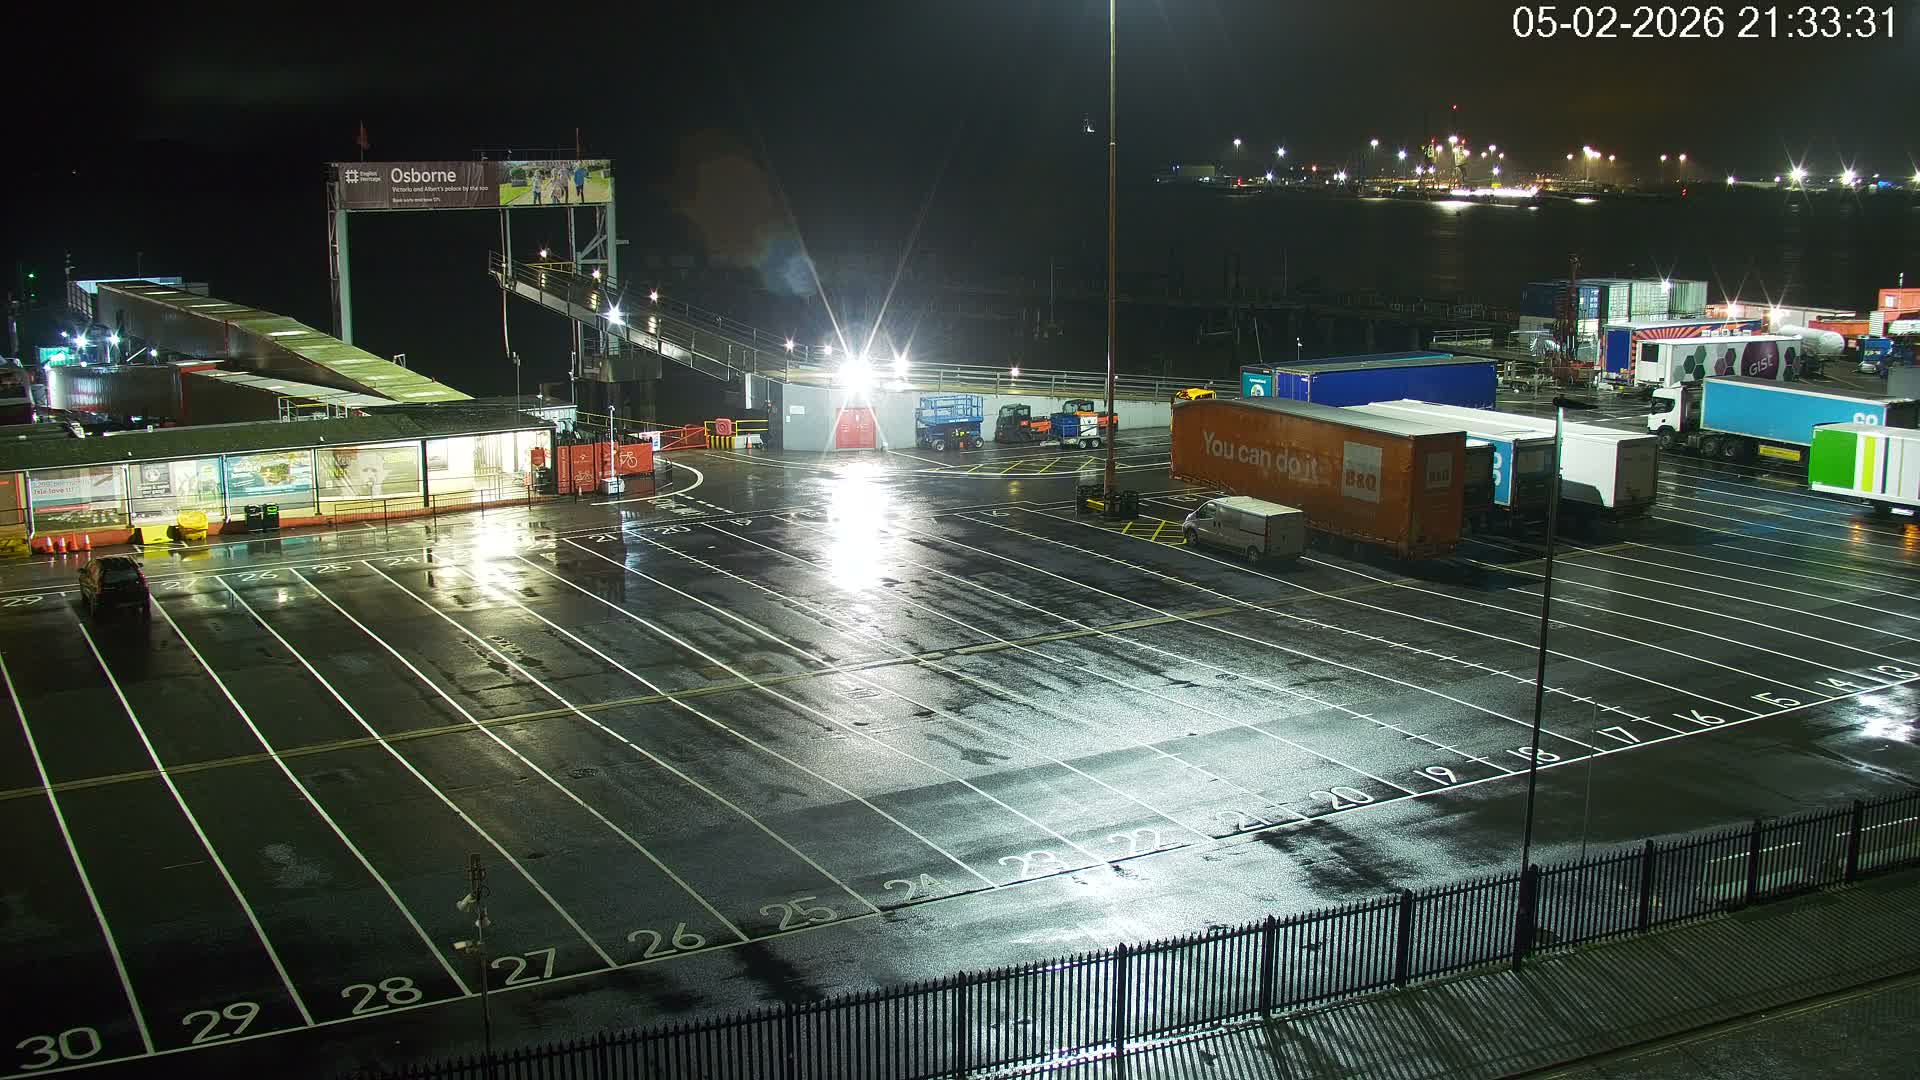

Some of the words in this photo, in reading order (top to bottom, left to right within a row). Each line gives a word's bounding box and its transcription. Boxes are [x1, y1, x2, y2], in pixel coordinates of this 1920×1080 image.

[391, 168, 457, 183] Osborne
[1203, 431, 1234, 461] You
[1238, 445, 1271, 472] can
[1276, 450, 1300, 475] do
[1304, 455, 1318, 480] it
[1345, 469, 1377, 492] B&Q
[588, 533, 618, 543] 21
[654, 525, 691, 535] 20
[312, 563, 352, 574] 25
[383, 556, 420, 567] 24
[238, 571, 279, 583] 26
[3, 594, 44, 608] 29
[1869, 665, 1920, 680] 13
[1815, 676, 1870, 693] 14
[1751, 692, 1801, 709] 15
[1672, 709, 1726, 727] 16
[1596, 726, 1641, 744] 17
[1506, 747, 1561, 765] 18
[1413, 766, 1458, 786] 19
[1309, 786, 1375, 810] 20
[1216, 811, 1274, 832] 21
[1107, 828, 1184, 852] 22
[999, 850, 1070, 878] 23
[883, 873, 953, 901] 24
[759, 896, 838, 931] 25
[627, 922, 707, 959] 26
[491, 948, 557, 986] 27
[341, 976, 423, 1015] 28
[182, 1001, 261, 1044] 29
[15, 1026, 102, 1070] 30
